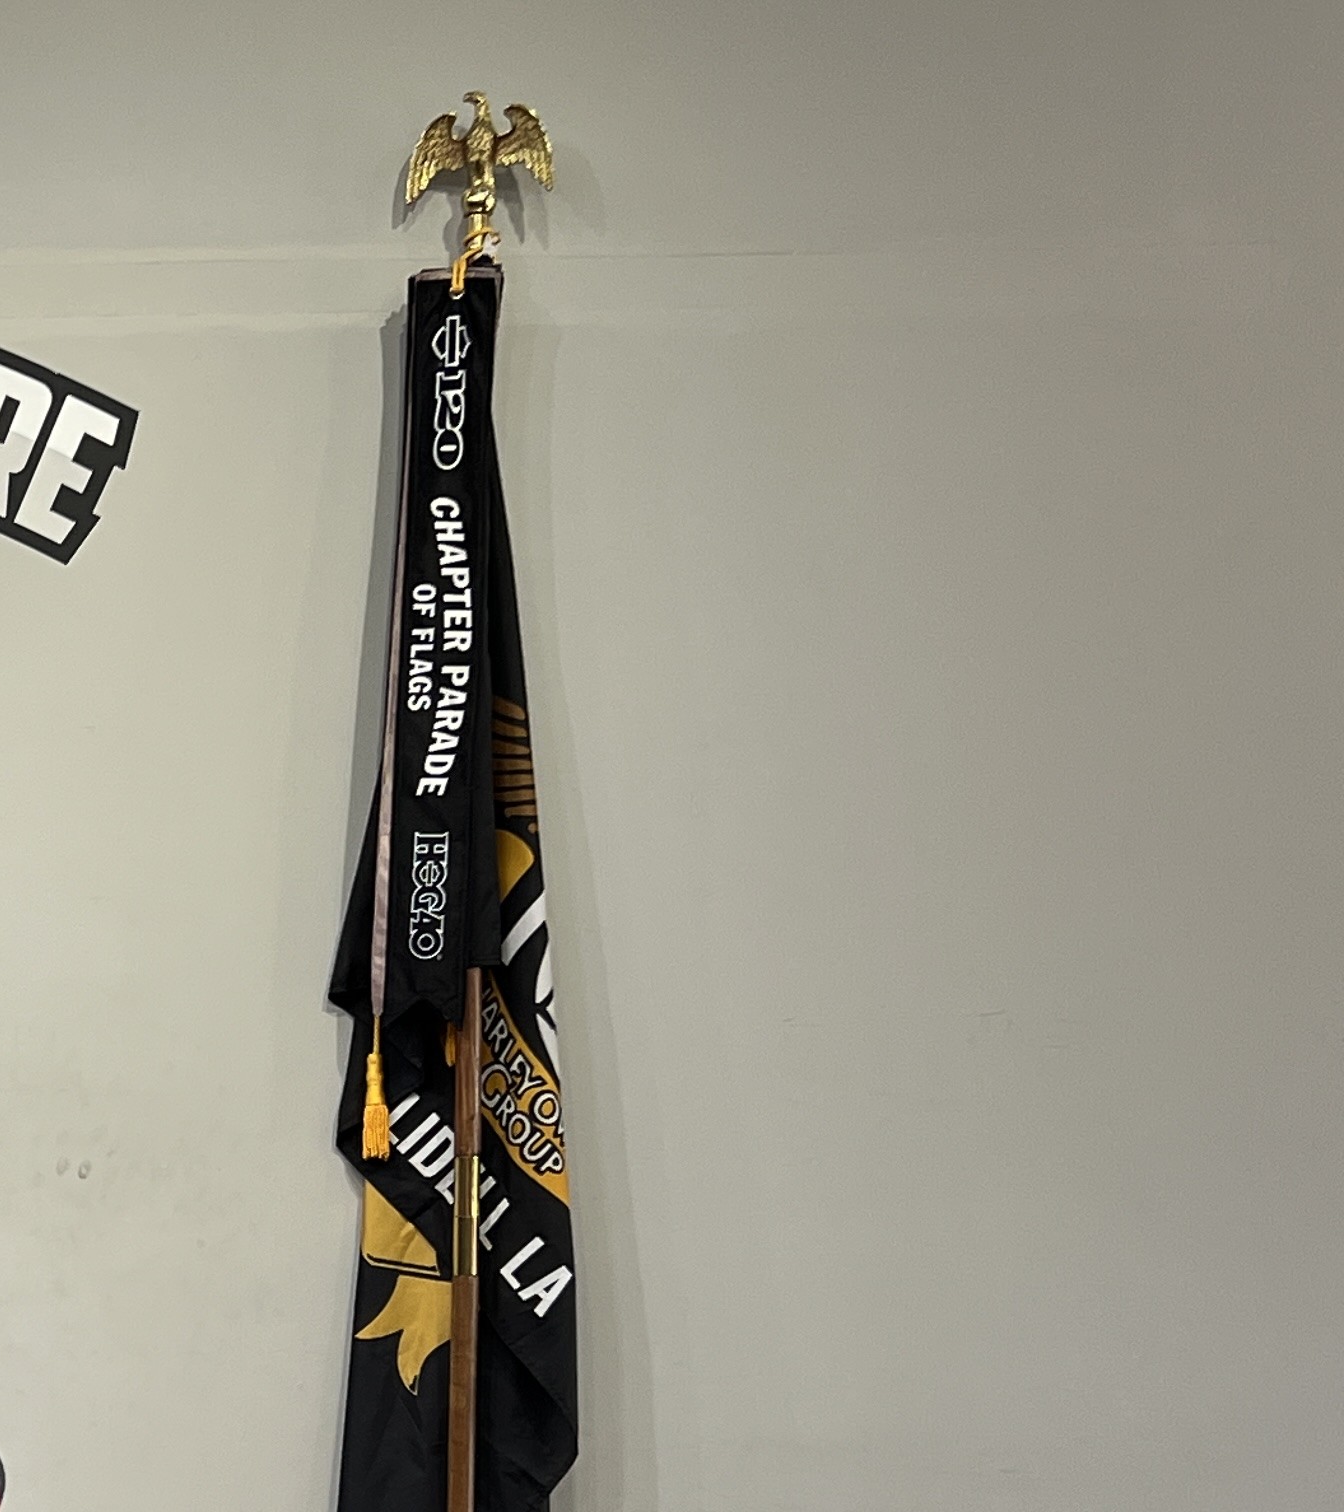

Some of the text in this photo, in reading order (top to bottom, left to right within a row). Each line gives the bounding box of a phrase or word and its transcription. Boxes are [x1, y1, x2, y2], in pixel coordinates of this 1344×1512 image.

[407, 583, 437, 711] OF FLAGS
[415, 497, 473, 796] CHAPTER PARADE
[481, 1063, 563, 1172] GROUP
[499, 1236, 573, 1318] LA
